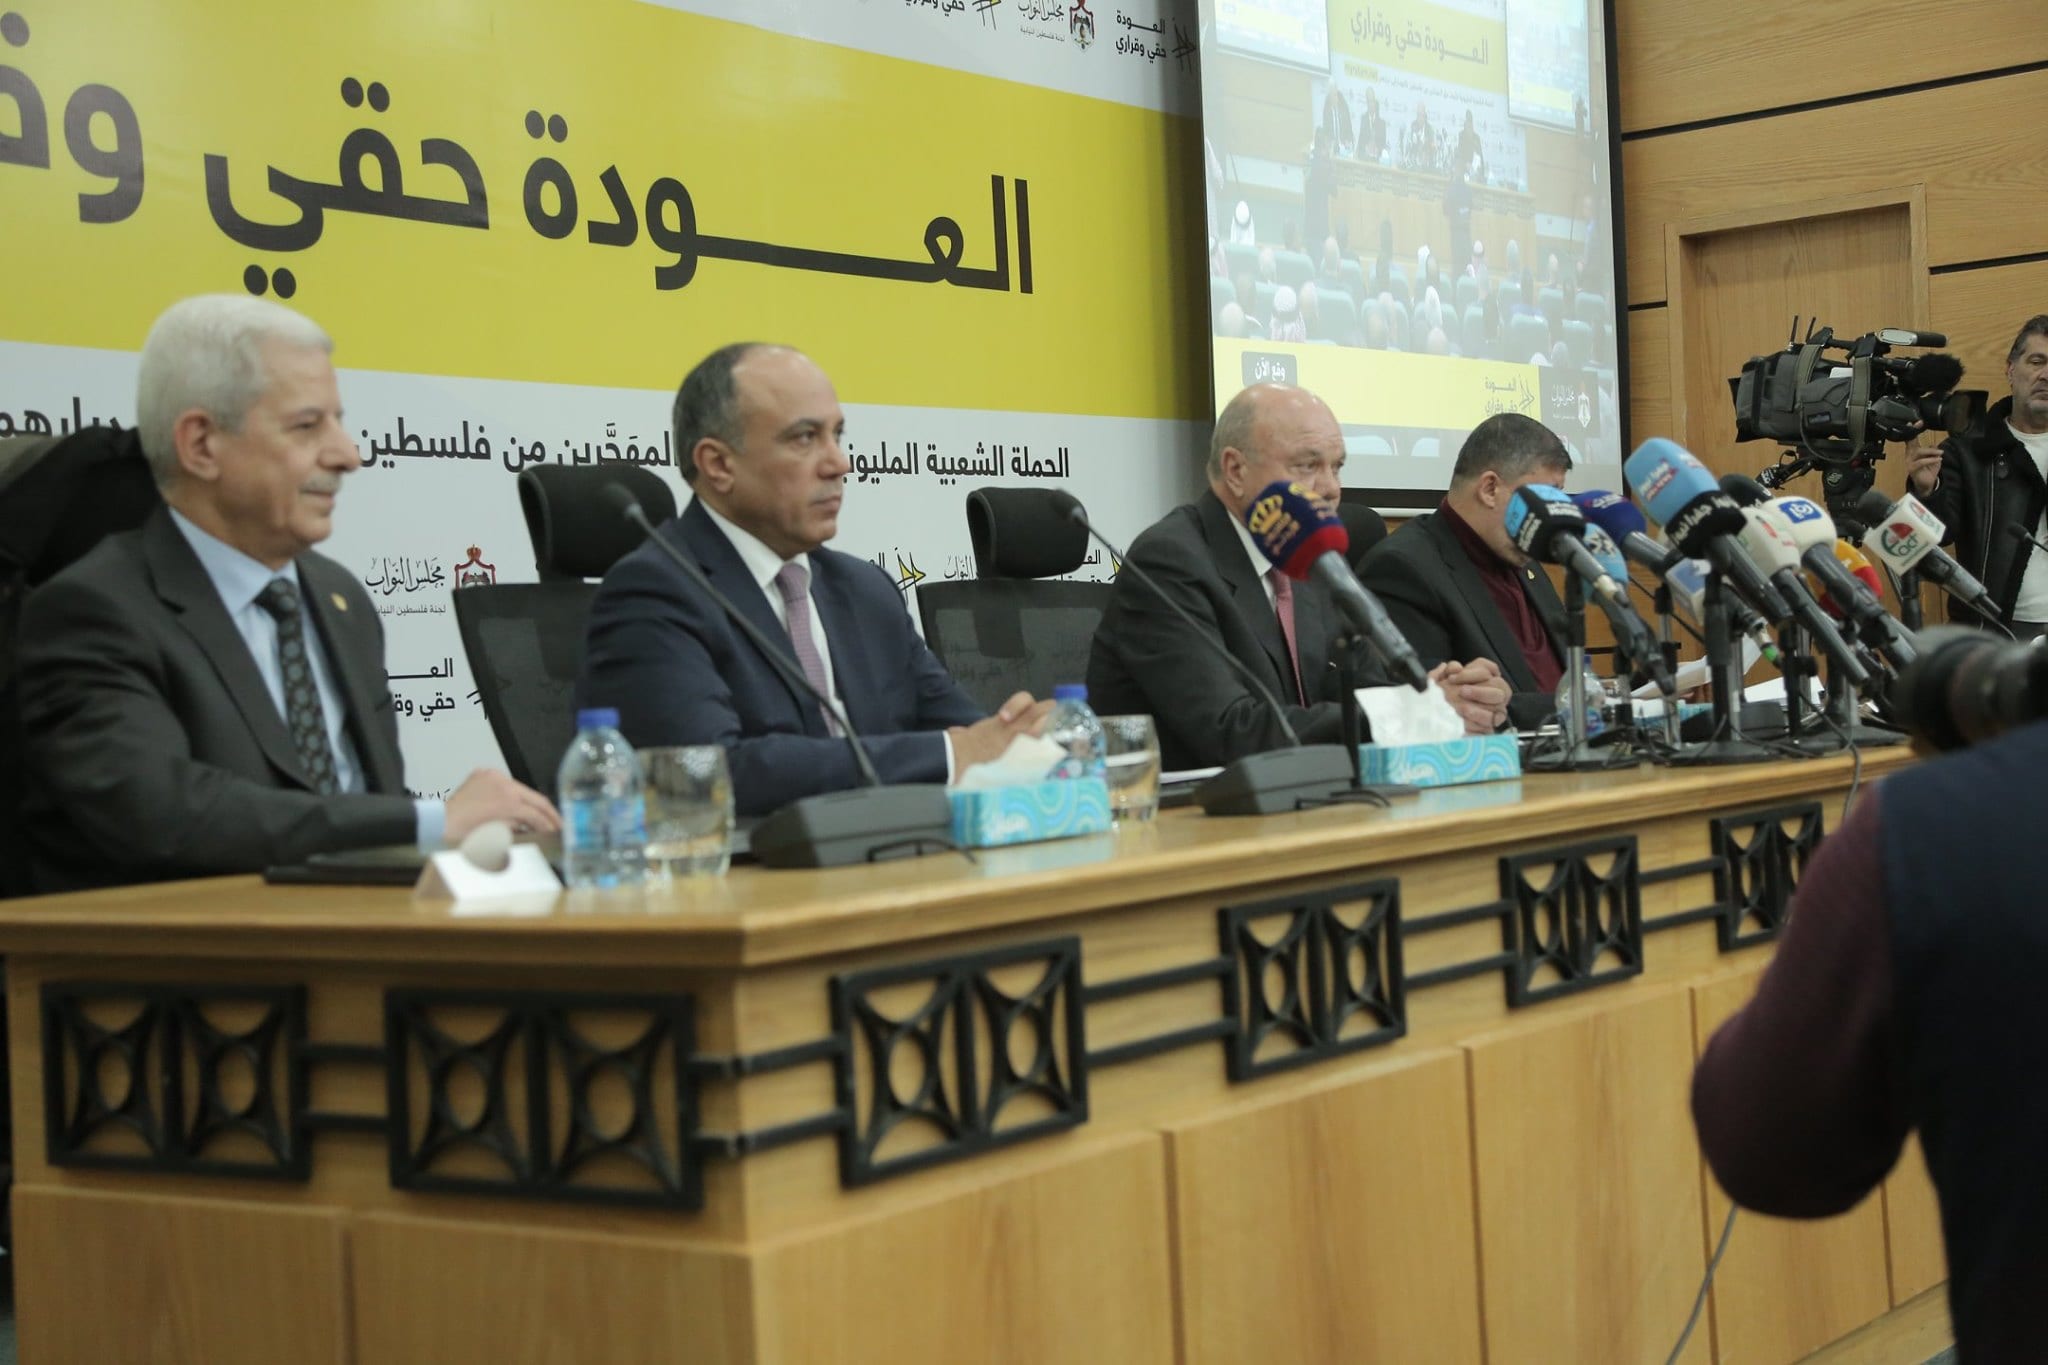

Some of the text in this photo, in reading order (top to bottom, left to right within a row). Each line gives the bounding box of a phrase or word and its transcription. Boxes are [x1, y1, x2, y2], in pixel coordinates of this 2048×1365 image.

[1116, 9, 1166, 35] العودة
[1350, 7, 1489, 65] العودة حقي وقراري
[1115, 34, 1167, 63] حقي وقراري
[203, 76, 490, 299] حقي
[522, 109, 1034, 294] العودة
[355, 416, 492, 470] فلسطين
[502, 436, 547, 473] من
[926, 441, 1005, 486] الشعبية
[1011, 446, 1070, 478] الحملة
[419, 692, 456, 722] حقي
